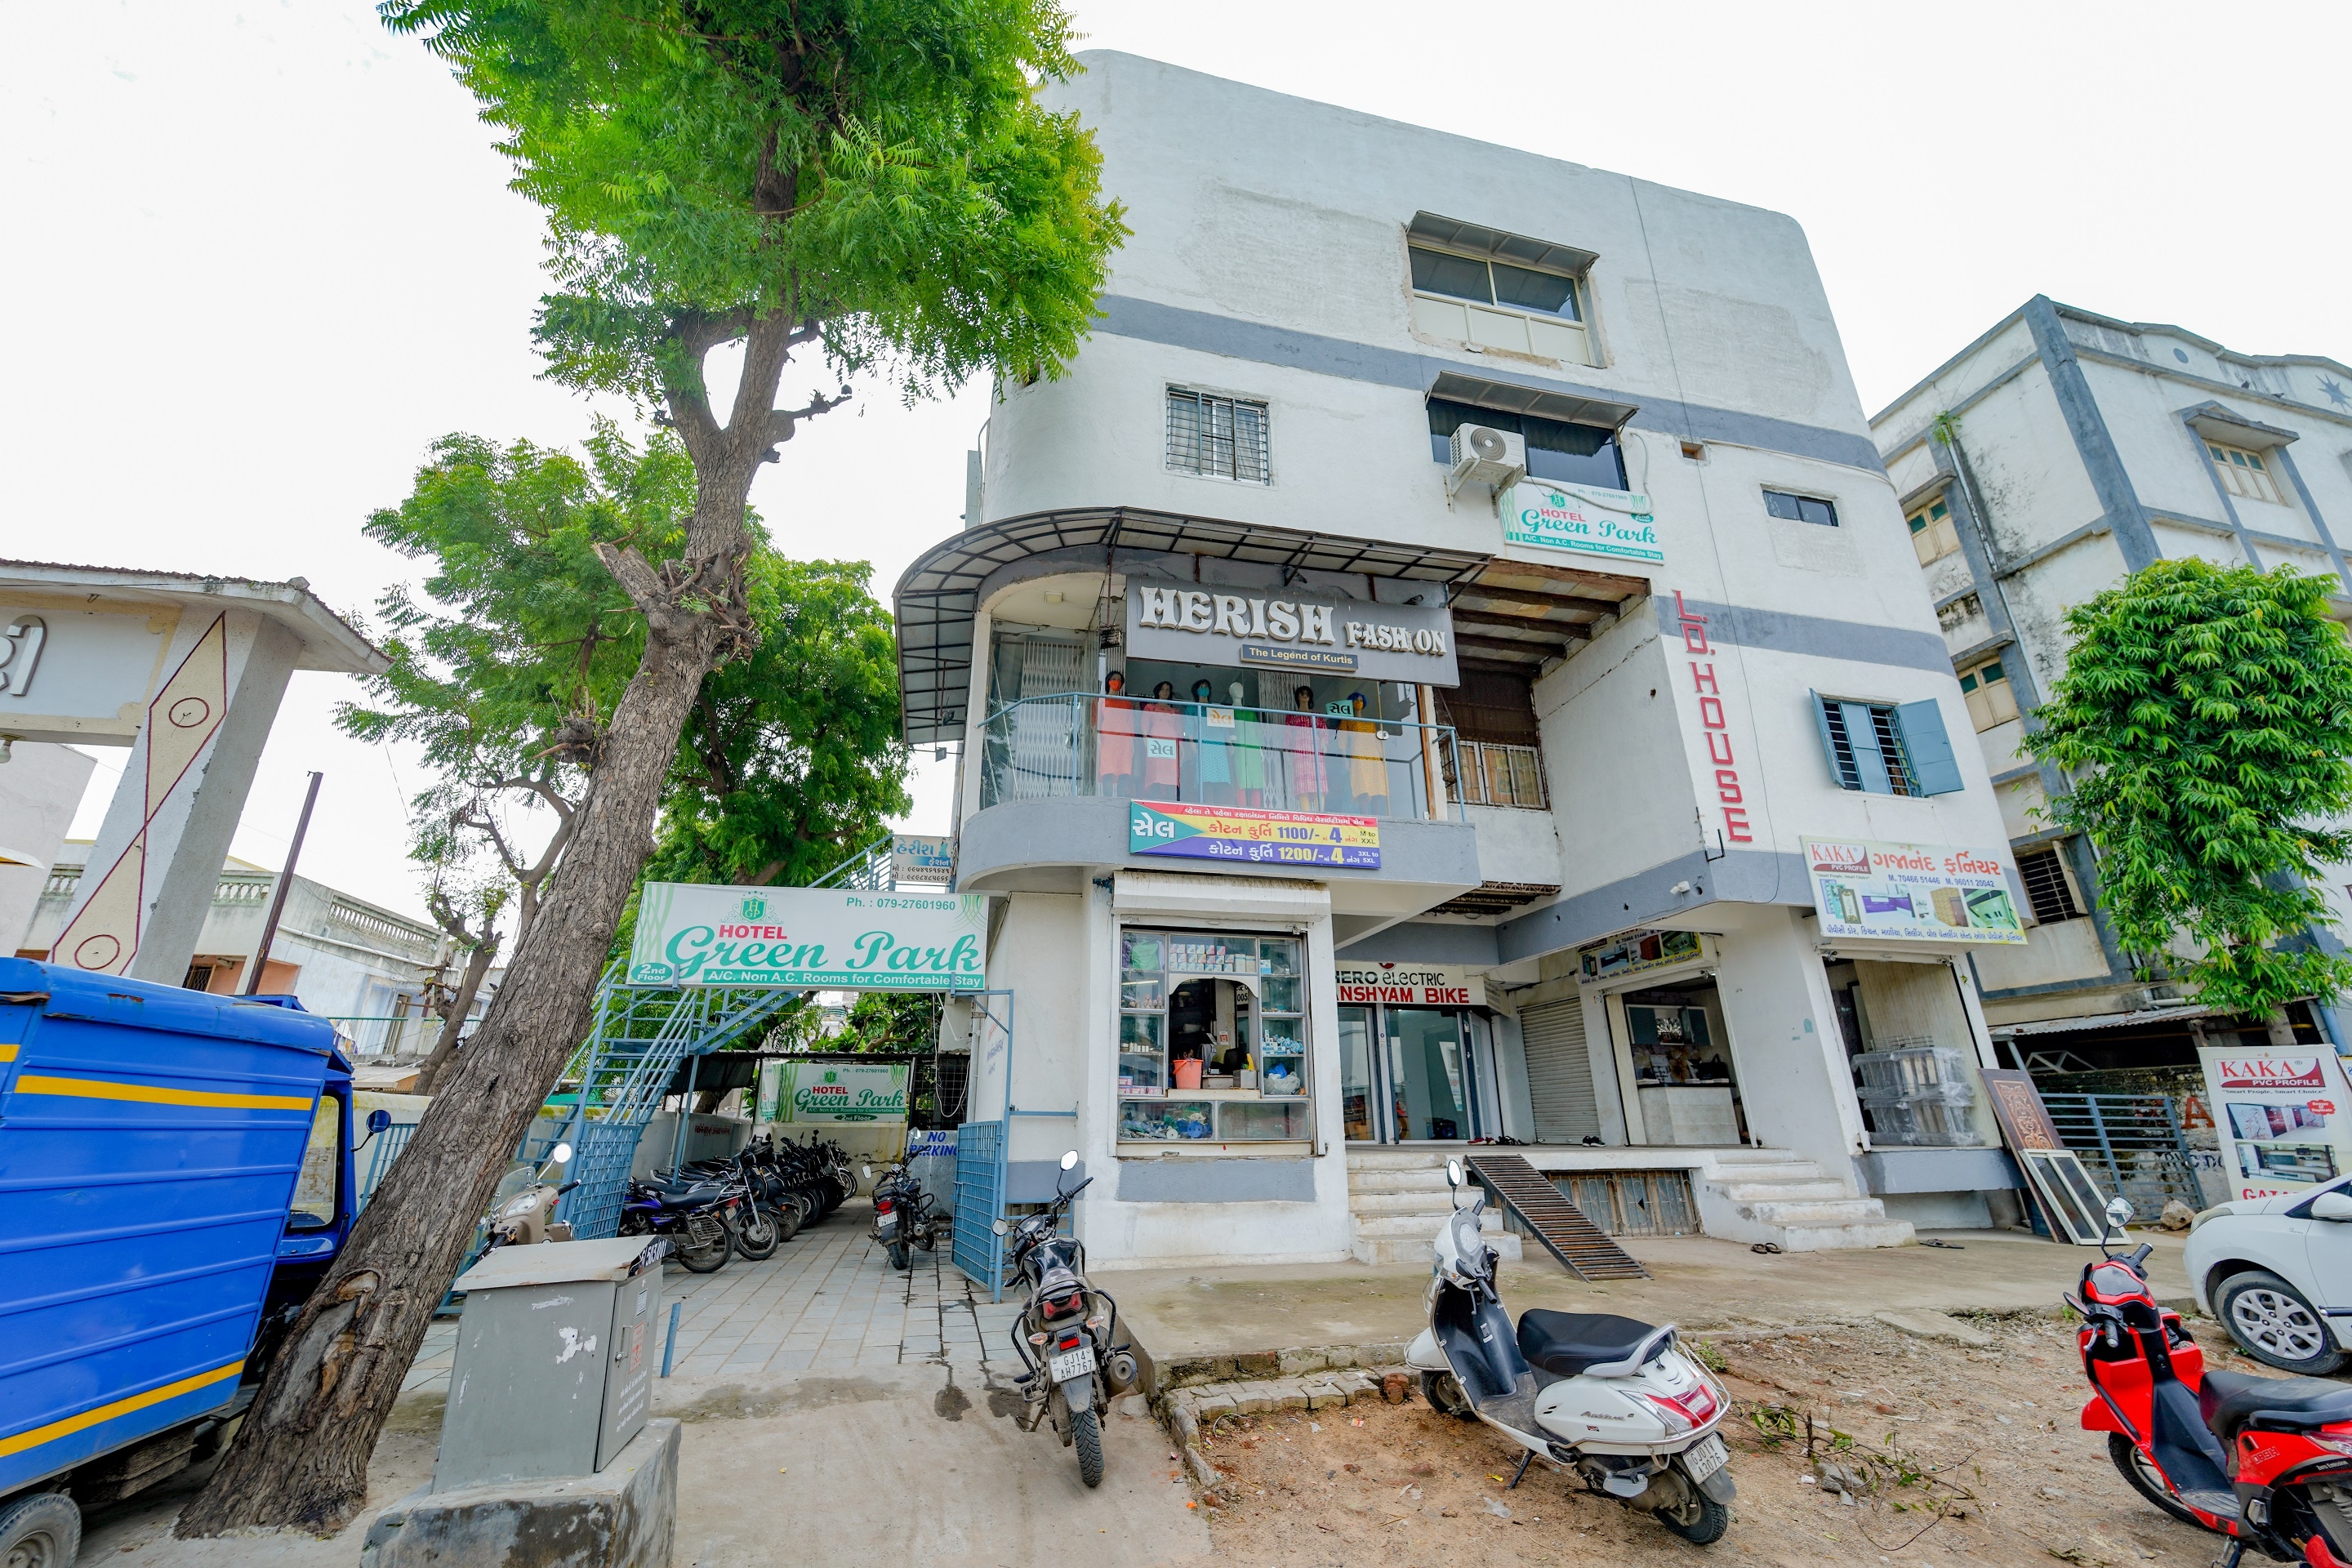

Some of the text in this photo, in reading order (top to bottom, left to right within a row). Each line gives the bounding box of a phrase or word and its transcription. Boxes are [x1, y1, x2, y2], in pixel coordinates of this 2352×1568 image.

[1540, 508, 1587, 522] HOTEL
[1521, 509, 1658, 544] Green Park
[1556, 538, 1570, 546] A.C.
[1570, 541, 1594, 550] Rooms
[1606, 545, 1646, 556] Comfortable
[1646, 550, 1661, 559] Stay
[1139, 586, 1336, 645] HERISH
[1250, 648, 1353, 665] The Legend of Kurtis
[1209, 710, 1232, 724] સેલ
[1330, 702, 1352, 715] સેલ
[1150, 740, 1174, 755] સેલ
[1689, 662, 1753, 843] HOUSE
[1132, 812, 1175, 839] સેલ
[1214, 808, 1232, 817] પહેલા
[1352, 817, 1365, 826] સેલ
[1208, 821, 1242, 835] કોટન
[1248, 822, 1272, 840] કુર્તિ
[1277, 826, 1320, 840] 1100/-
[1330, 826, 1342, 843] 4
[896, 837, 934, 855] હેરીશ
[1208, 841, 1242, 856] કોટન
[1249, 843, 1273, 862] કુર્તિ
[1278, 847, 1323, 861] 1200/-
[1330, 847, 1344, 864] 4
[1810, 844, 1856, 862] KAKA
[929, 858, 949, 866] ફેશન
[1873, 850, 2001, 875] ગજાનંદ ફર્નિચર
[1898, 875, 1918, 883] 70466
[1954, 878, 1974, 886] 96011
[846, 898, 865, 907] Ph.
[876, 898, 956, 911] 079-27601960
[719, 924, 787, 939] HOTEL
[666, 925, 981, 978] Green Park
[639, 964, 666, 974] 2nd
[708, 971, 980, 987] A/C. Non A.C. Rooms for Comfortable Stay
[1336, 986, 1414, 1003] NSHYAM
[1424, 987, 1470, 1004] BIKE
[2221, 1060, 2296, 1077] KAKA
[813, 1086, 849, 1094] HOTEL
[795, 1088, 849, 1111] Green
[856, 1089, 904, 1107] Park
[927, 1132, 946, 1142] NO
[1064, 1351, 1086, 1366] GJ14
[1061, 1360, 1092, 1379] AH7767
[1698, 1452, 1723, 1478] A3076
